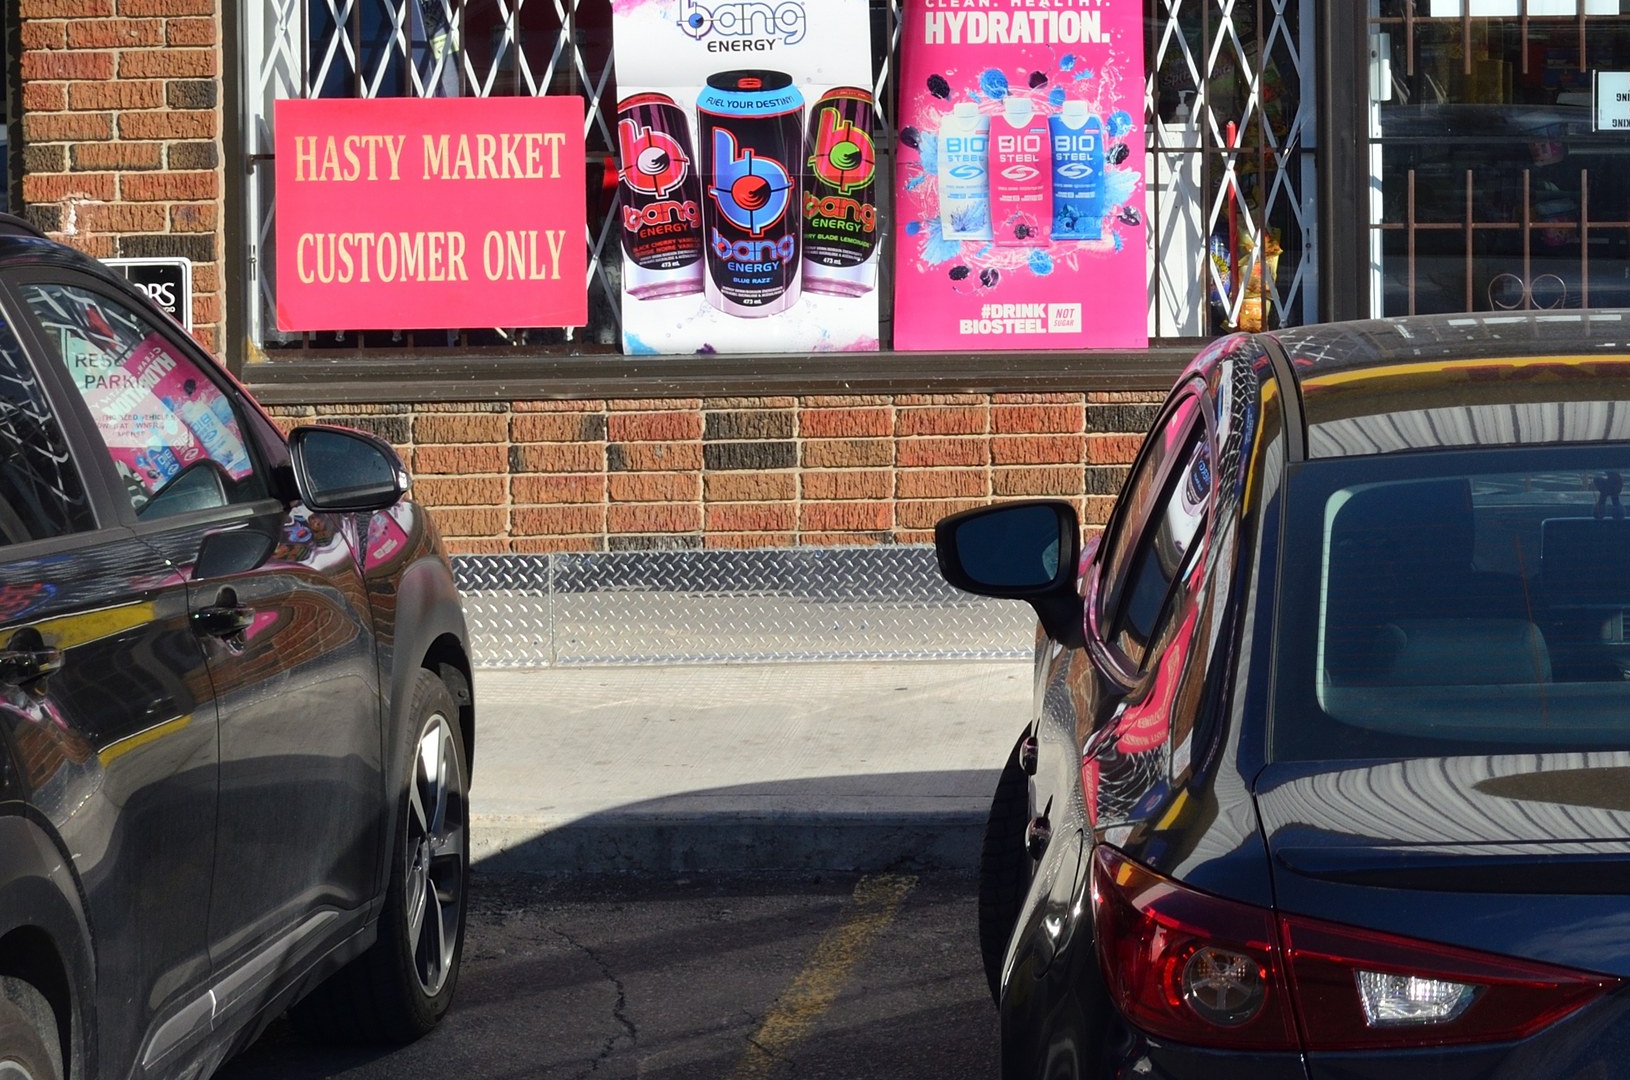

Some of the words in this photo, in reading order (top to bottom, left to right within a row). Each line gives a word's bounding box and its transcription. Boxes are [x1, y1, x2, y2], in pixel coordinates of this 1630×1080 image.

[924, 10, 1111, 45] HYDRATION.
[707, 39, 776, 52] ENERGY
[705, 96, 724, 108] FUEL
[727, 100, 753, 109] YOUR
[946, 136, 985, 153] BIO
[998, 135, 1040, 153] BIO
[1055, 135, 1095, 152] BIO
[294, 134, 407, 183] HASTY
[422, 132, 567, 181] MARKET
[999, 153, 1040, 162] STEEL
[1056, 152, 1094, 161] STEEL
[640, 222, 688, 239] ENERGY
[812, 219, 861, 232] ENERGY
[712, 226, 795, 264] bang
[297, 231, 469, 285] CUSTOMER
[484, 229, 567, 281] ONLY
[728, 261, 780, 273] ENERGY
[981, 303, 1047, 319] #DRINK
[1055, 307, 1075, 319] NOT
[960, 319, 1047, 335] BIOSTEEL
[1053, 318, 1074, 328] SUGAR
